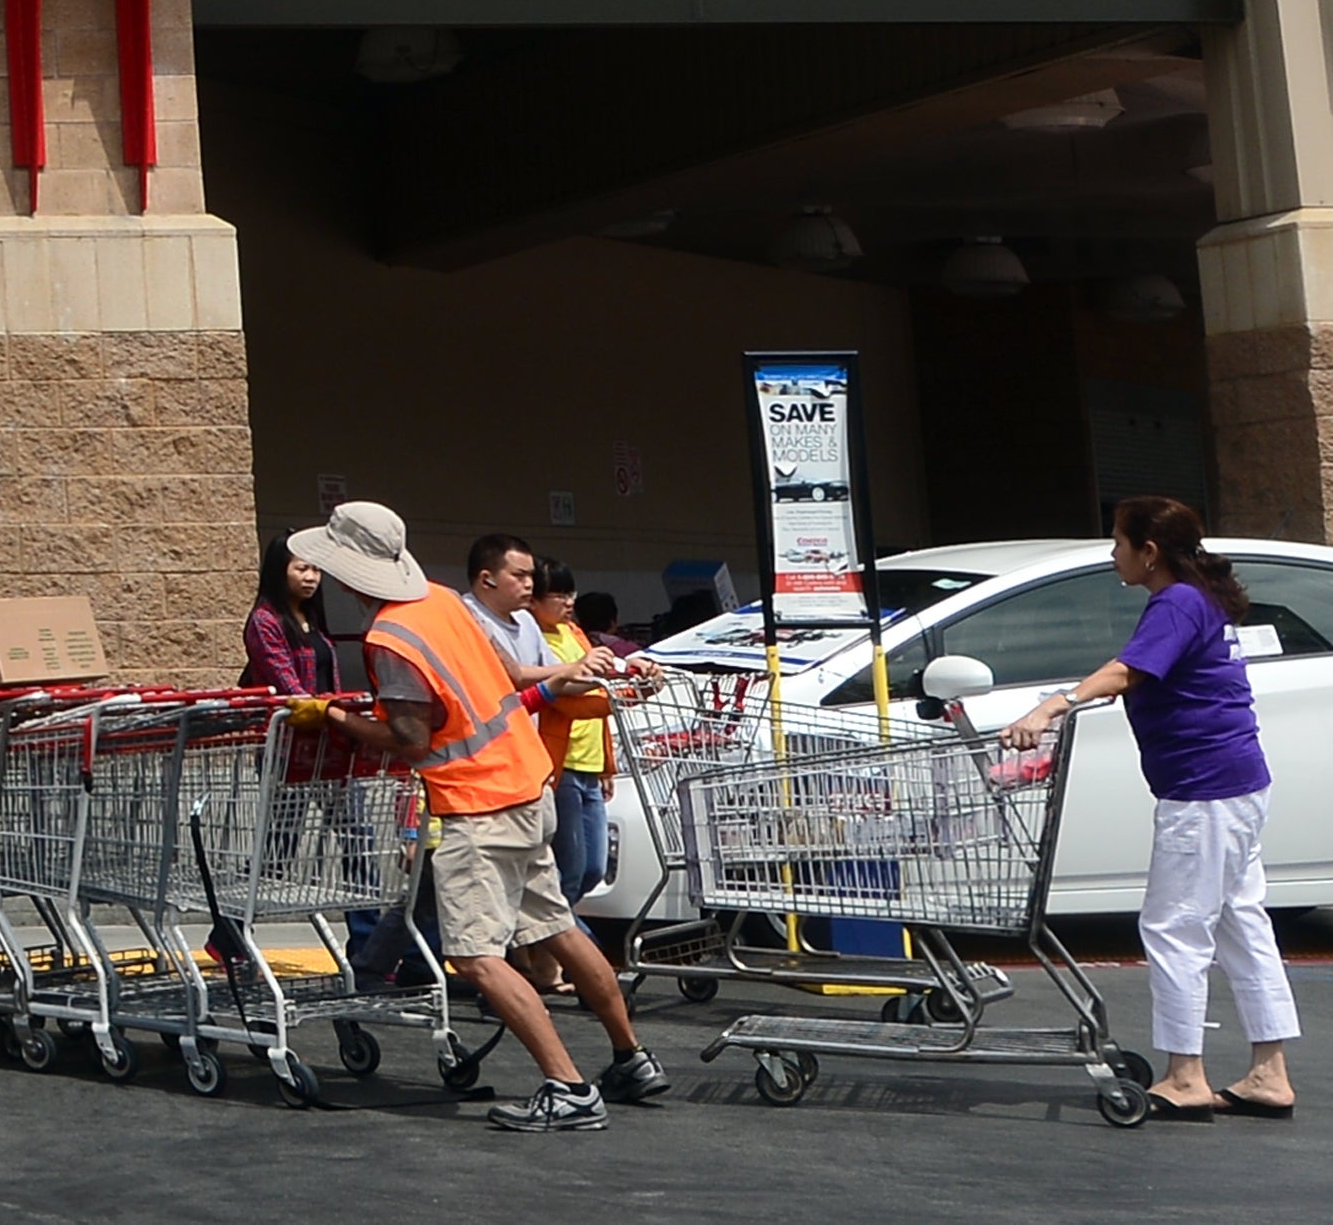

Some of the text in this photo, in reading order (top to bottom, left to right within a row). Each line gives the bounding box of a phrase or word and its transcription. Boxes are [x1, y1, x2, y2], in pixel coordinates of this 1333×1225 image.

[769, 403, 836, 422] SAVE
[770, 424, 837, 436] ON MANY
[772, 436, 822, 448] MAKES
[773, 449, 838, 462] MODELS
